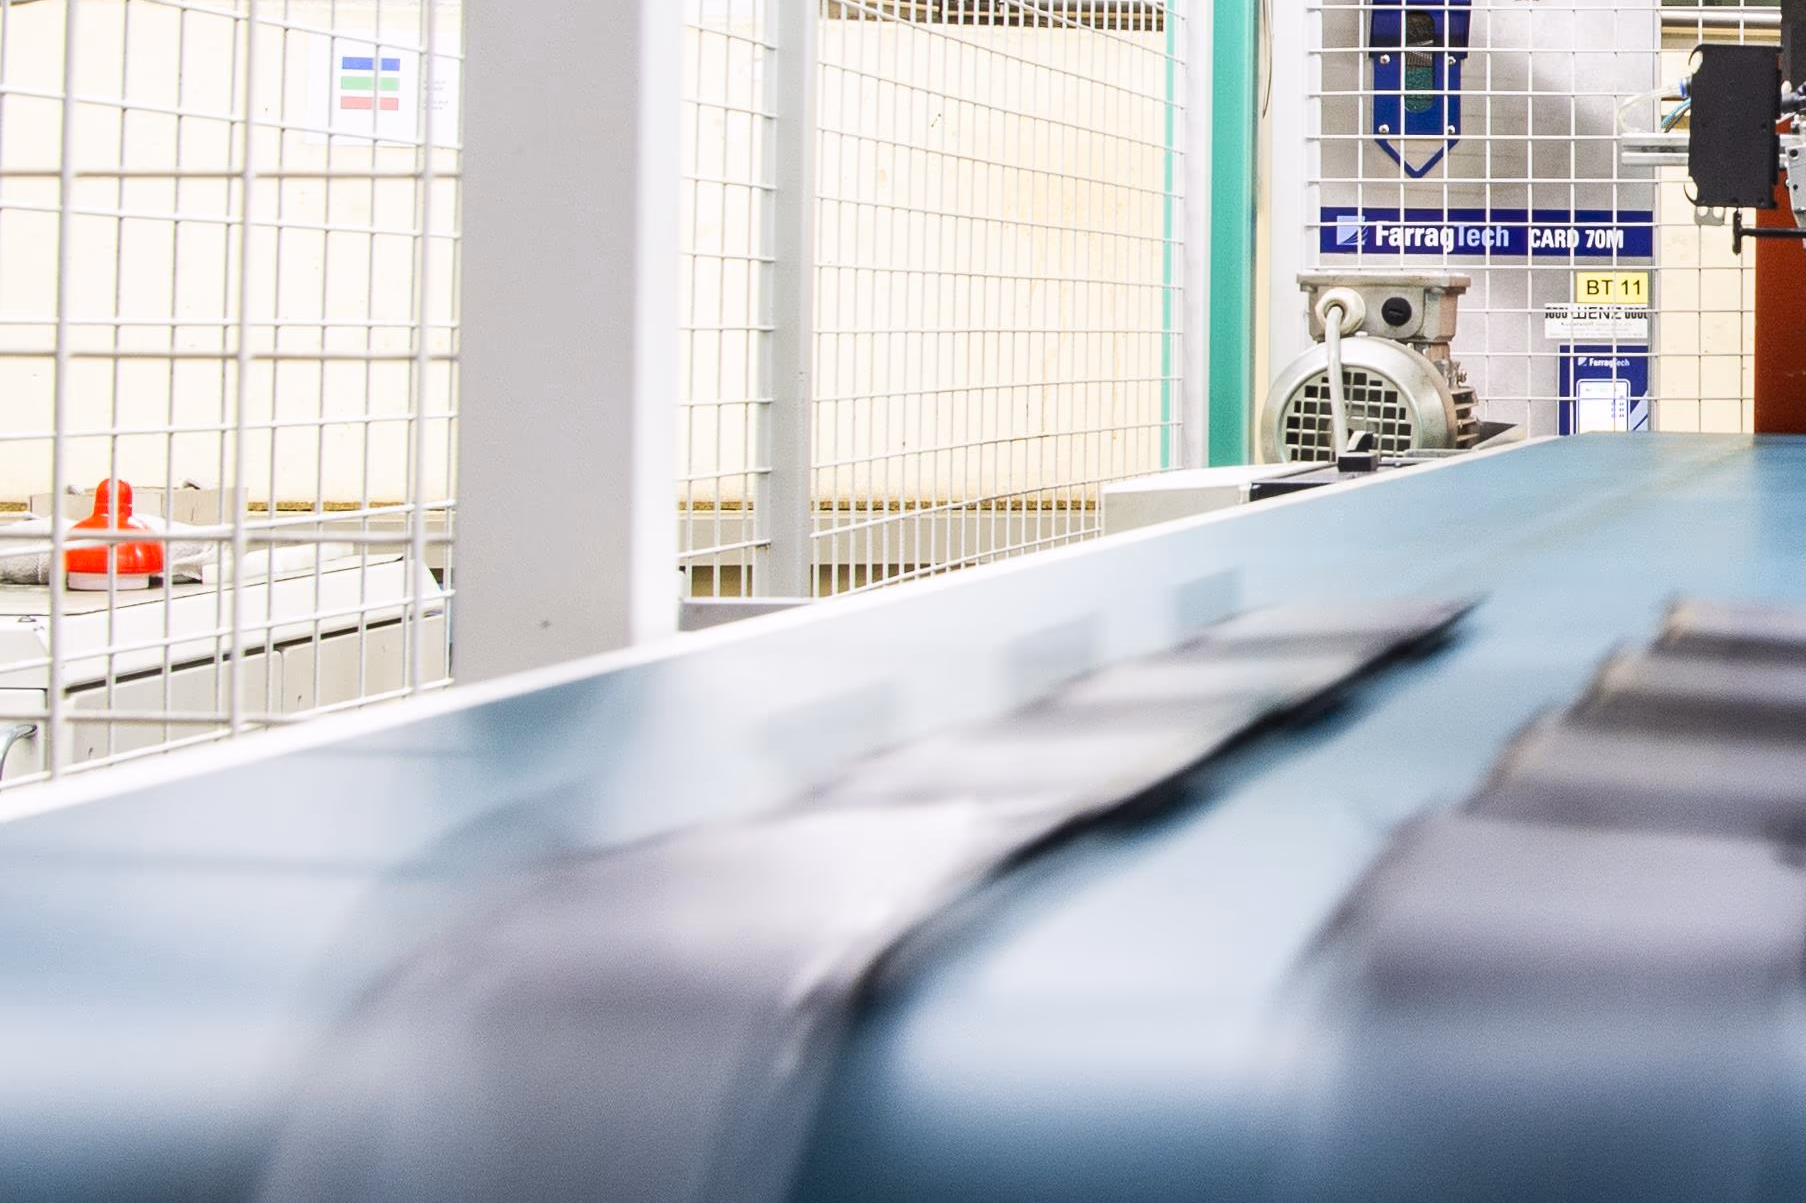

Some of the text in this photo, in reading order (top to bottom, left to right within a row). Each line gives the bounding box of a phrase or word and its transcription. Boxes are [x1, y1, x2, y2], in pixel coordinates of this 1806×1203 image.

[1375, 220, 1625, 253] FarragTech CARD 70M
[1586, 279, 1641, 295] BT 11
